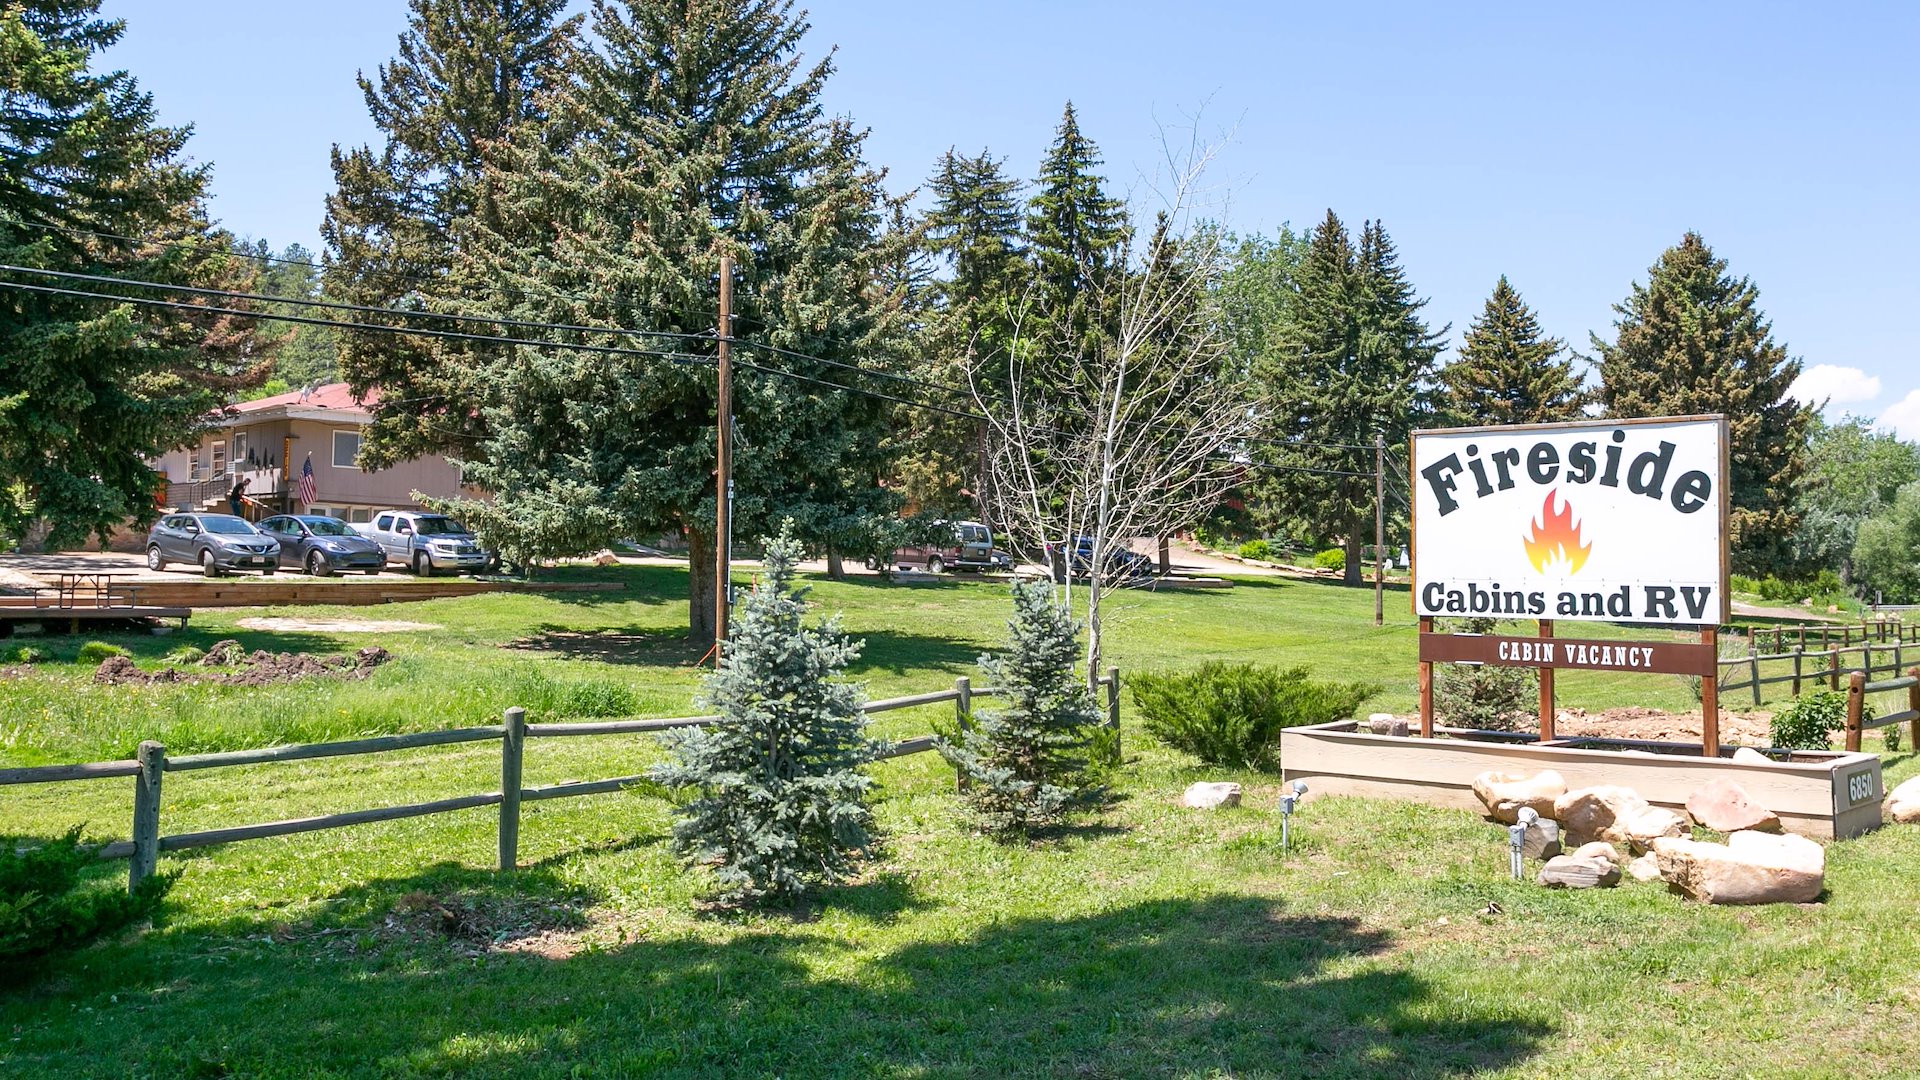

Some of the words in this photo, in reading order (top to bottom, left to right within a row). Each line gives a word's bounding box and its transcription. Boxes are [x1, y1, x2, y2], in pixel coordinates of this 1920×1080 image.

[1421, 429, 1712, 517] Fireside
[1422, 582, 1546, 615] Cabins
[1556, 585, 1633, 618] and
[1644, 586, 1711, 619] RV
[1498, 641, 1555, 663] CABIN
[1565, 644, 1654, 667] VACANCY
[1849, 773, 1873, 801] 6850
